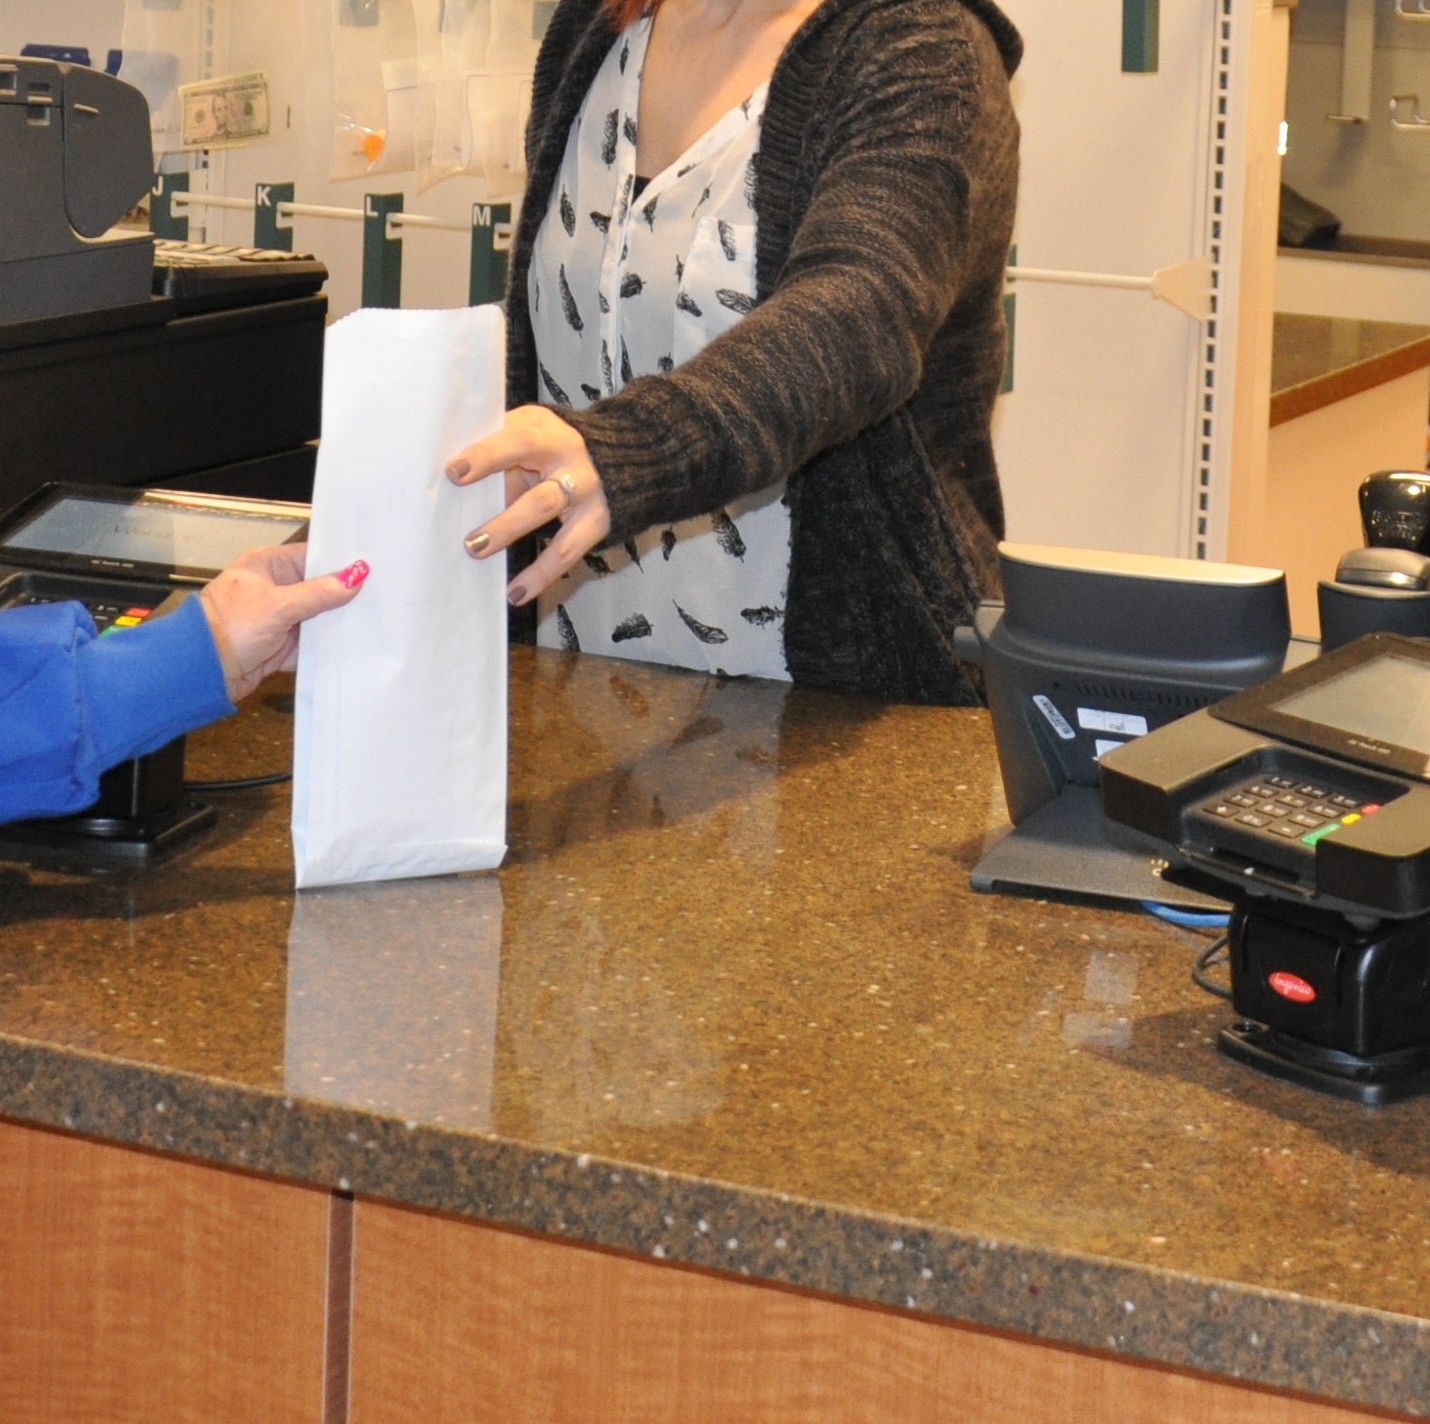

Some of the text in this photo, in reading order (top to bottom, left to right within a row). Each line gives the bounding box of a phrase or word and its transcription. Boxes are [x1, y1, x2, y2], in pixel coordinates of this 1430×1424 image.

[151, 175, 164, 196] J
[256, 185, 271, 207] K
[365, 196, 379, 217] L
[471, 205, 491, 227] M
